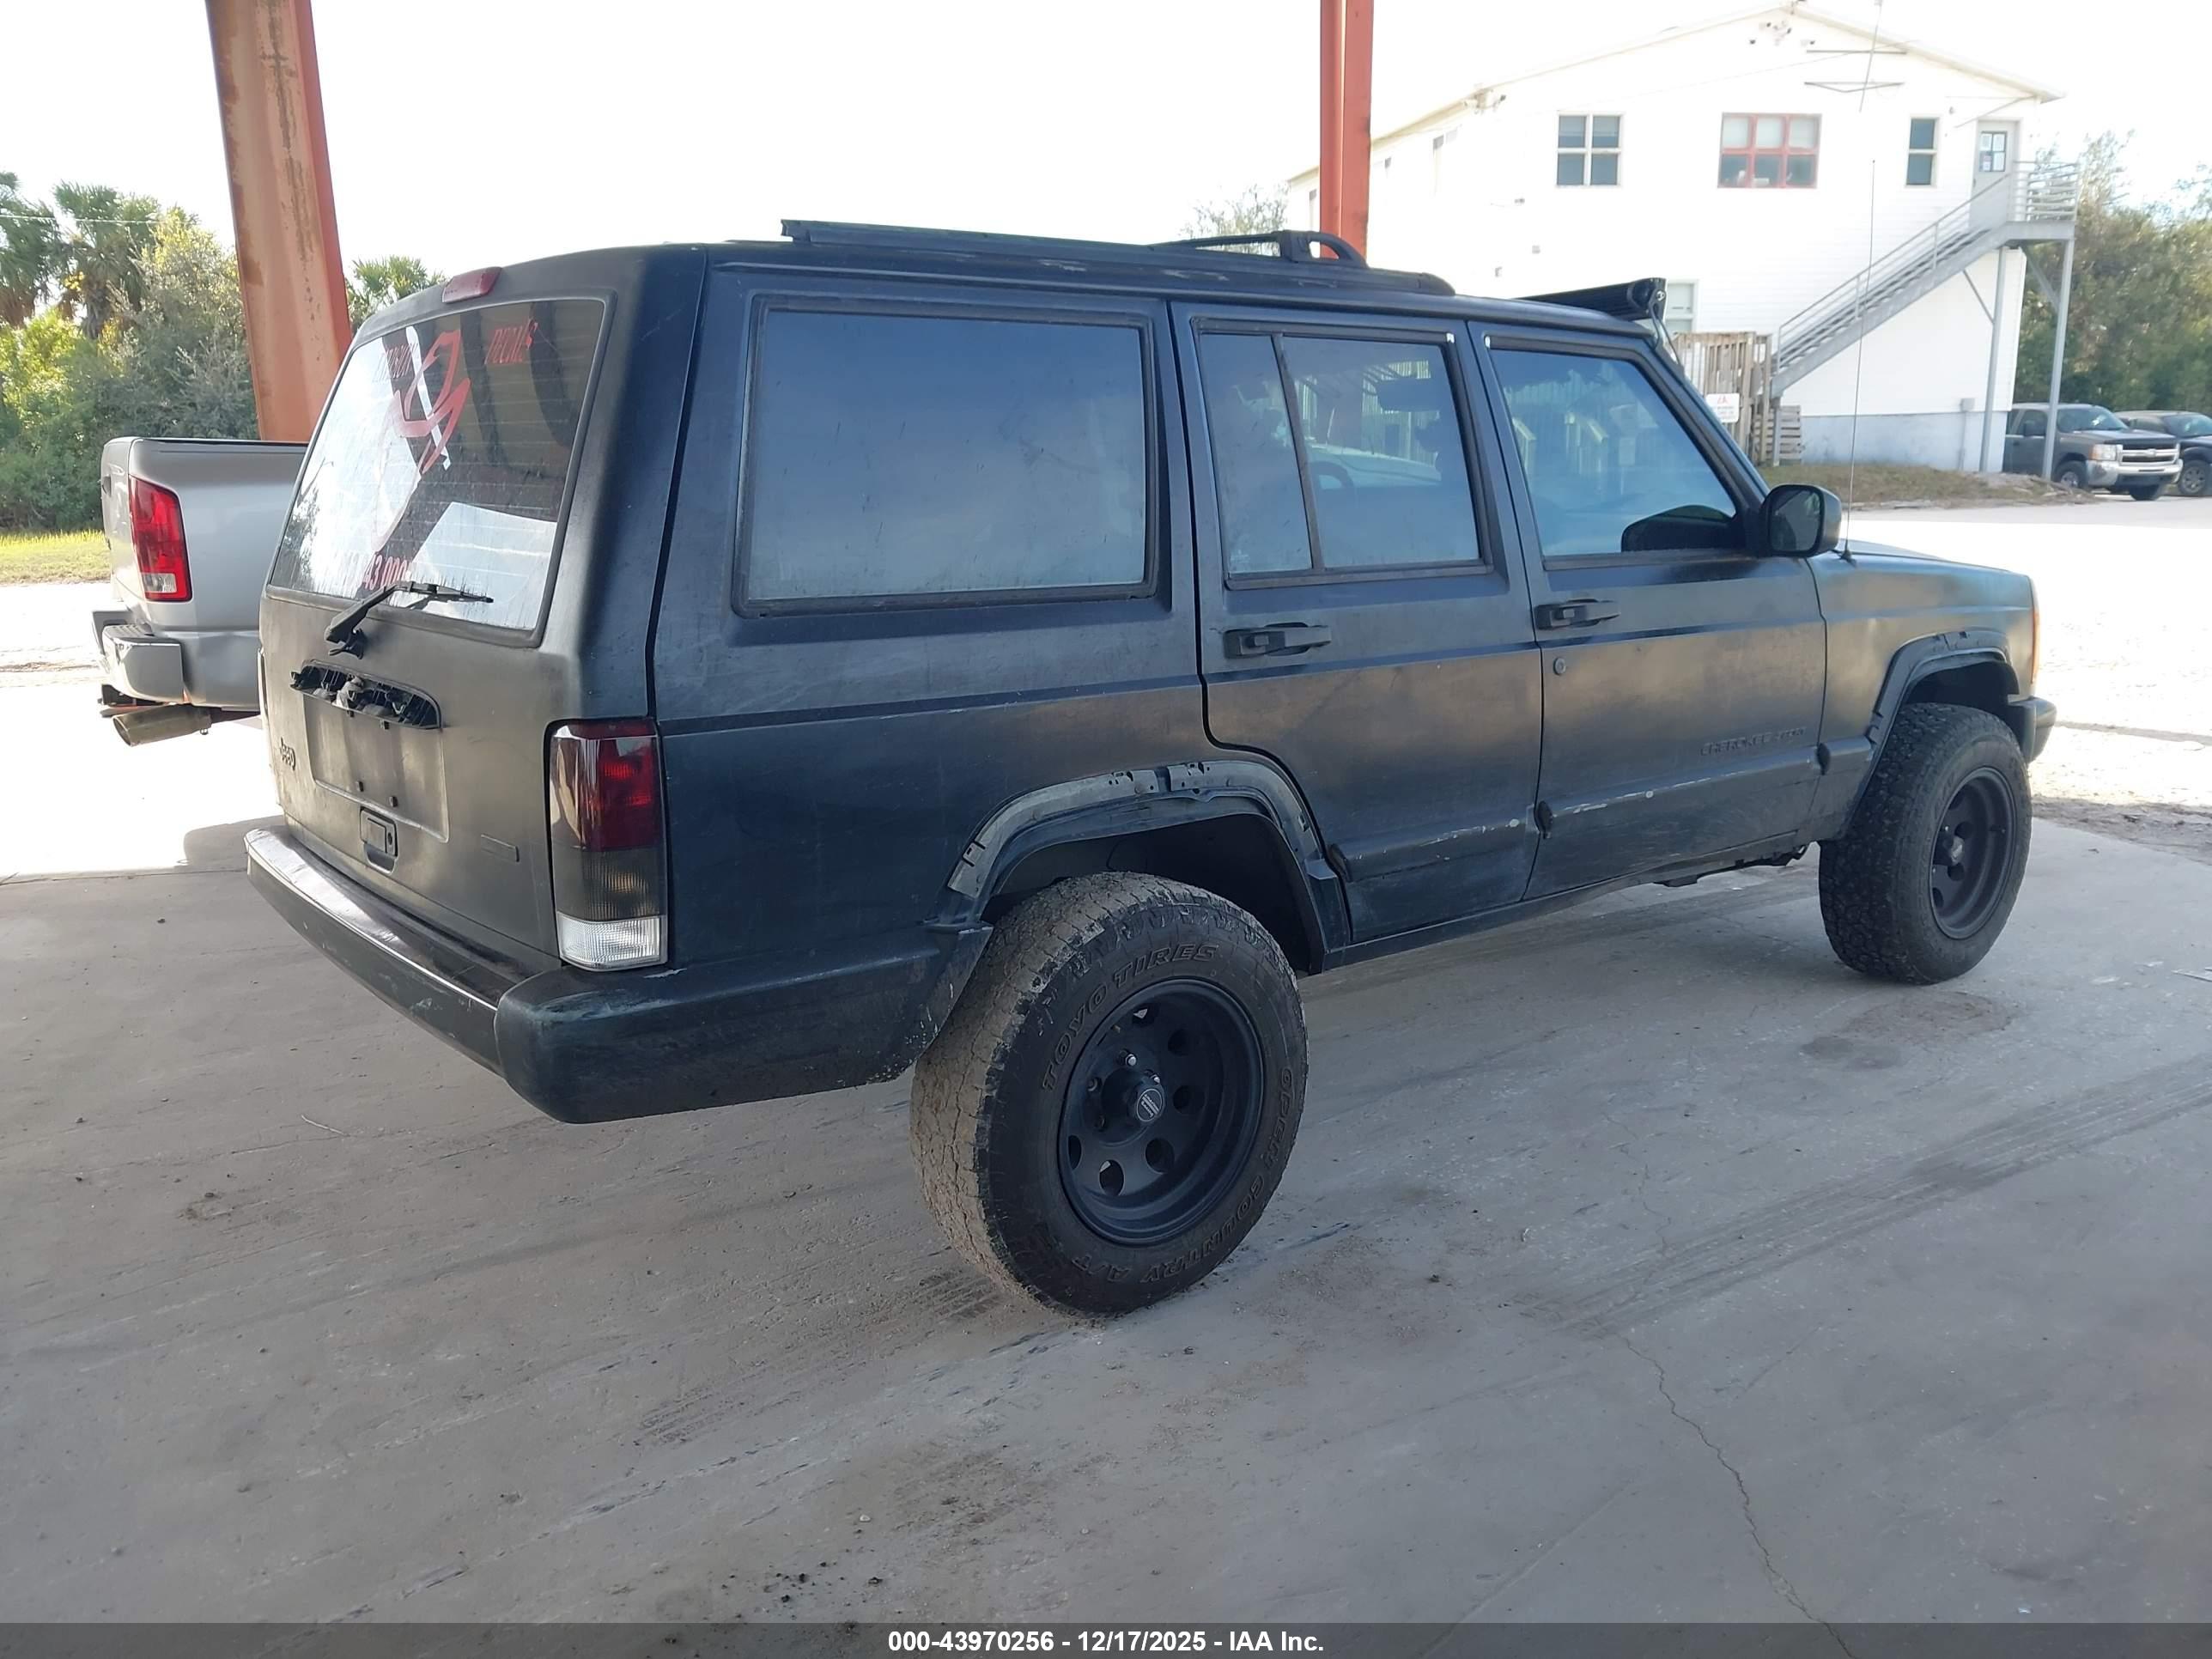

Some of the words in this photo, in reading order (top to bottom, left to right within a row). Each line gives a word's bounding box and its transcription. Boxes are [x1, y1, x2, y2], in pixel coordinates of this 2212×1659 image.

[279, 736, 296, 771] Jeep
[1042, 983, 1108, 1091] TOYO
[1113, 943, 1220, 988] TIRES
[1261, 1067, 1294, 1169] OPEN
[1139, 1174, 1266, 1284] COUNTRY
